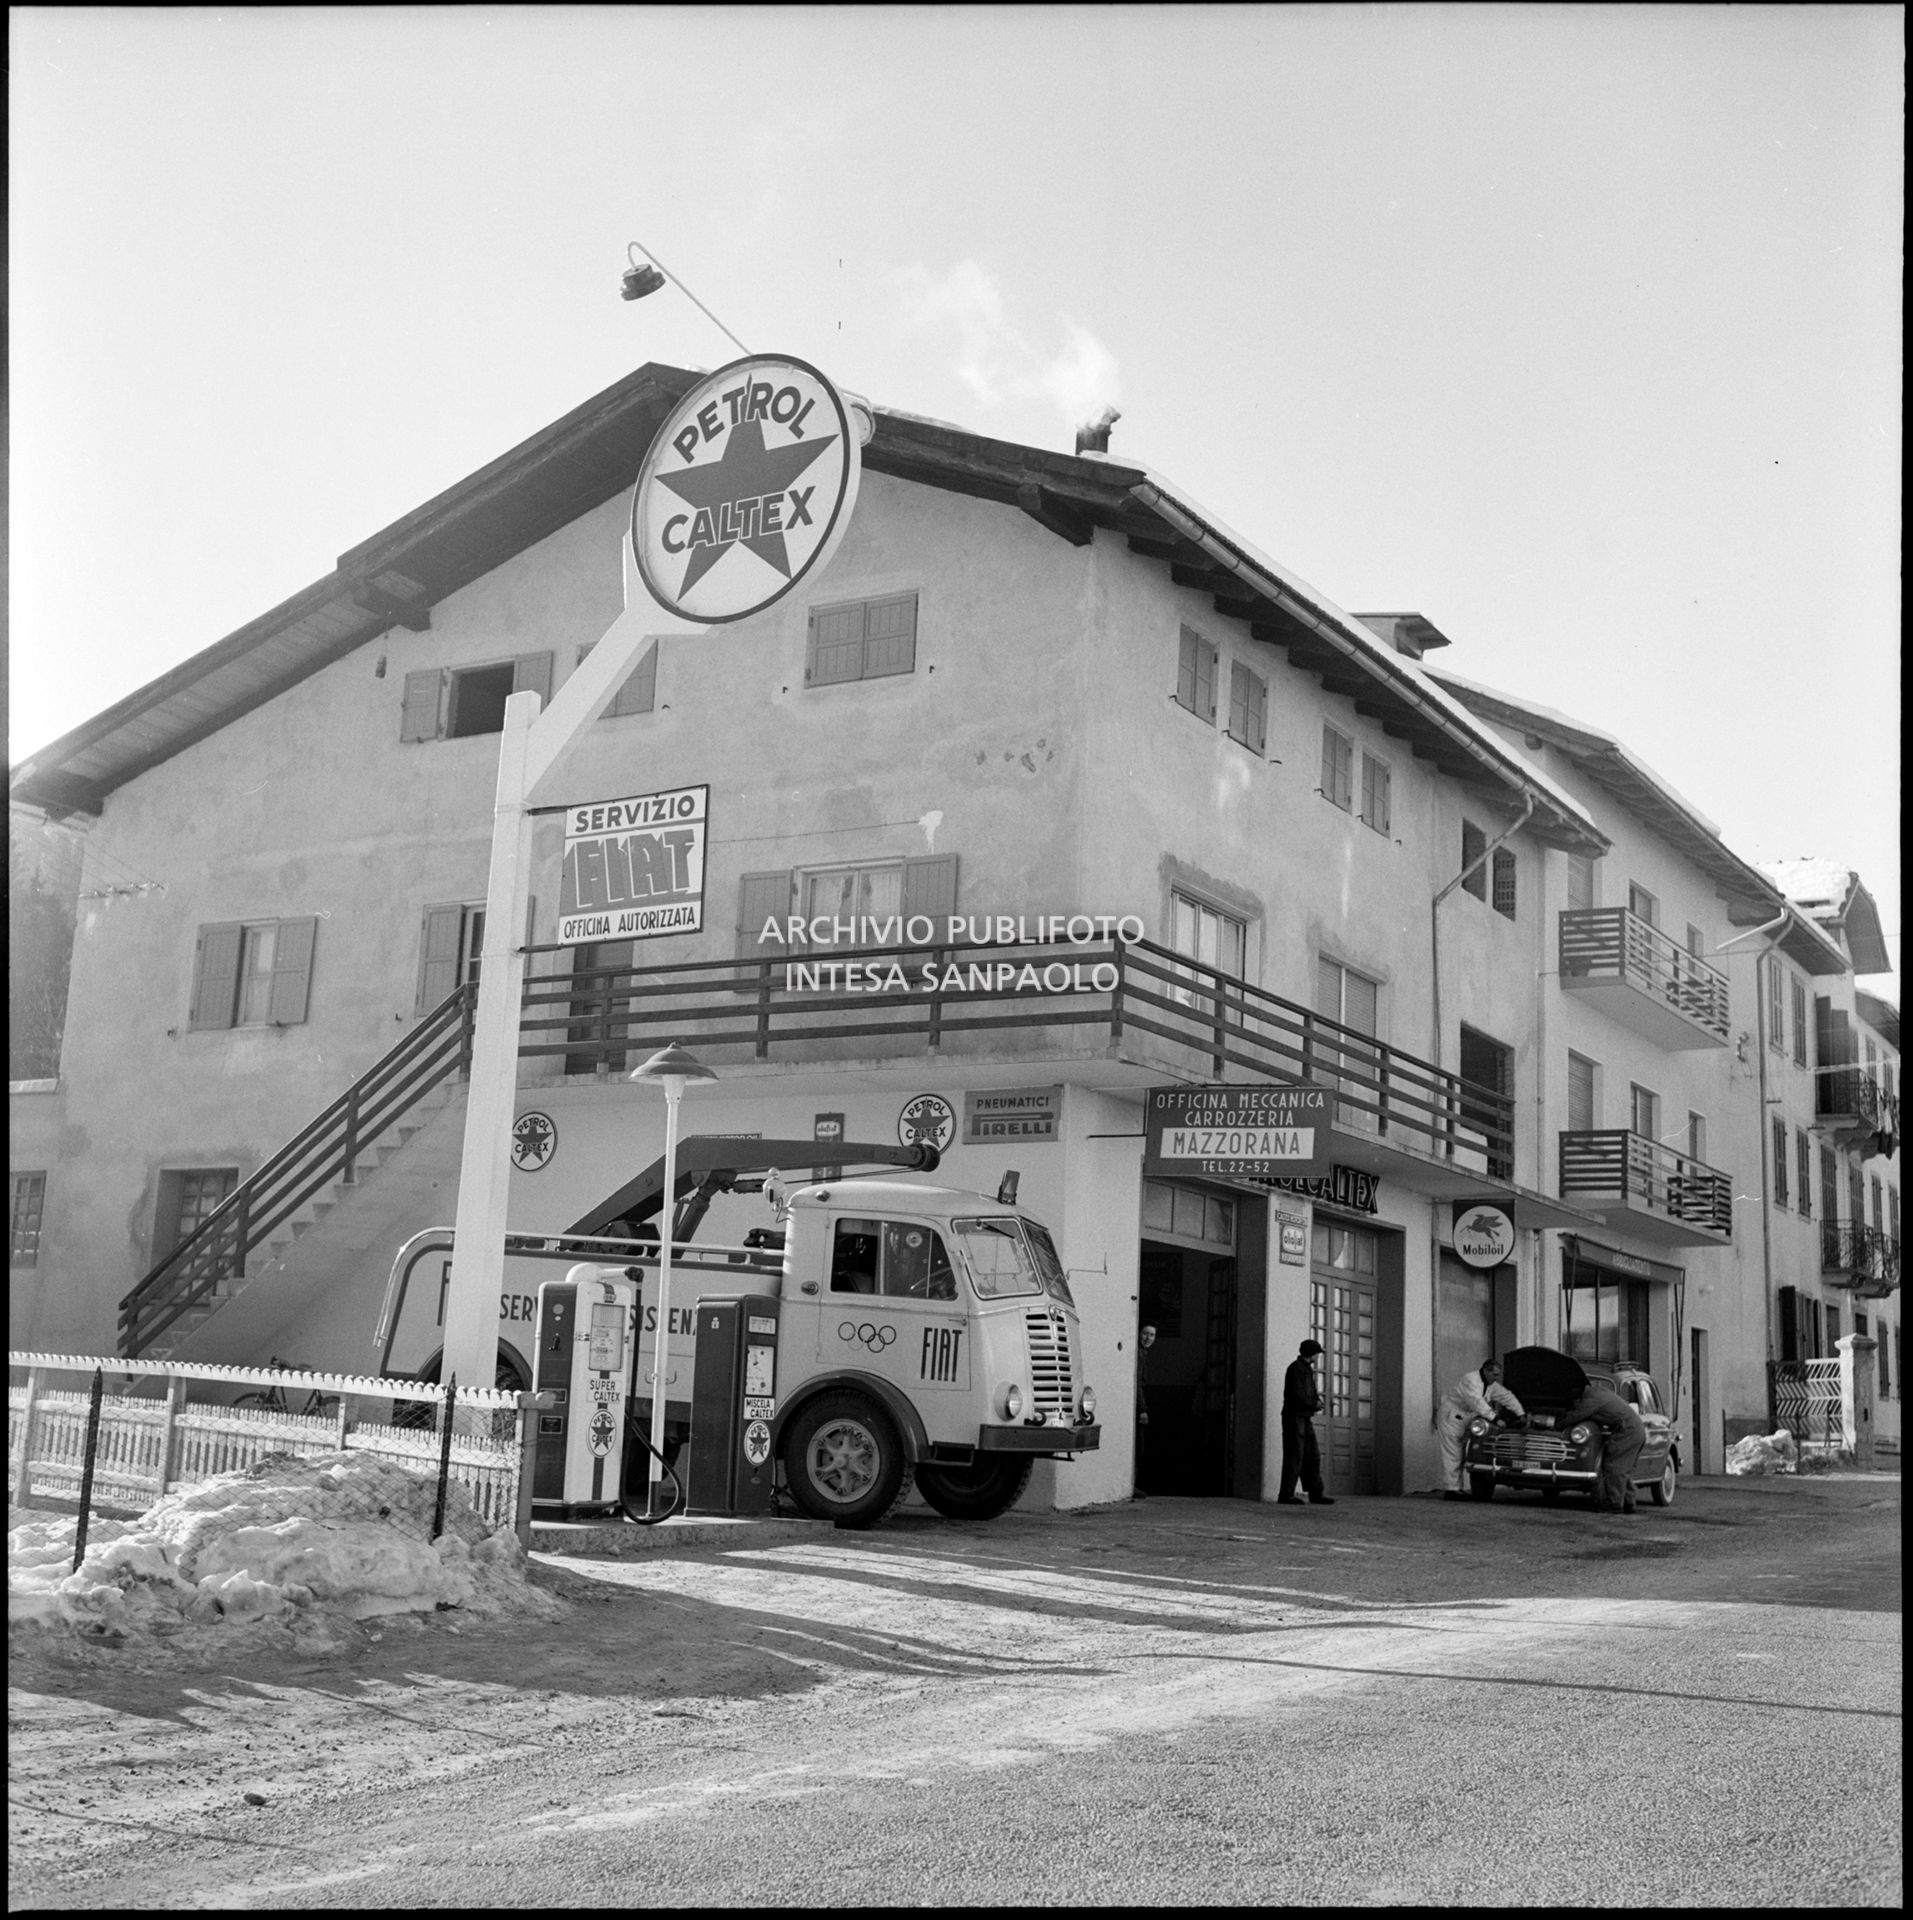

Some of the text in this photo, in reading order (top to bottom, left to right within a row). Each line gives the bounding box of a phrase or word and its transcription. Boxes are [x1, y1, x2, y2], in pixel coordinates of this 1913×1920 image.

[672, 382, 816, 464] PETROL
[661, 485, 816, 554] CALTEX
[575, 795, 695, 833] SERVIZIO
[573, 828, 695, 908] FIAT
[563, 906, 696, 939] OFFICINA AUTORIZZATA
[907, 1100, 946, 1118] PETROL
[976, 1096, 1049, 1110] PNEUMATICI
[1156, 1092, 1325, 1109] OFFICINA MECCANICA
[517, 1117, 549, 1134] PETROL
[971, 1112, 1054, 1136] PIRELLI
[1184, 1110, 1295, 1127] CARROZZERIA
[906, 1126, 947, 1140] CALTEX
[515, 1142, 549, 1153] CALTEX
[1172, 1131, 1301, 1155] MAZZORANA
[1462, 1244, 1504, 1256] Mobiloil
[920, 1327, 962, 1383] FIAT
[589, 1379, 616, 1391] SUPER
[593, 1391, 621, 1402] CALTEX
[746, 1399, 771, 1408] MISCELA
[750, 1409, 774, 1418] CALTEX
